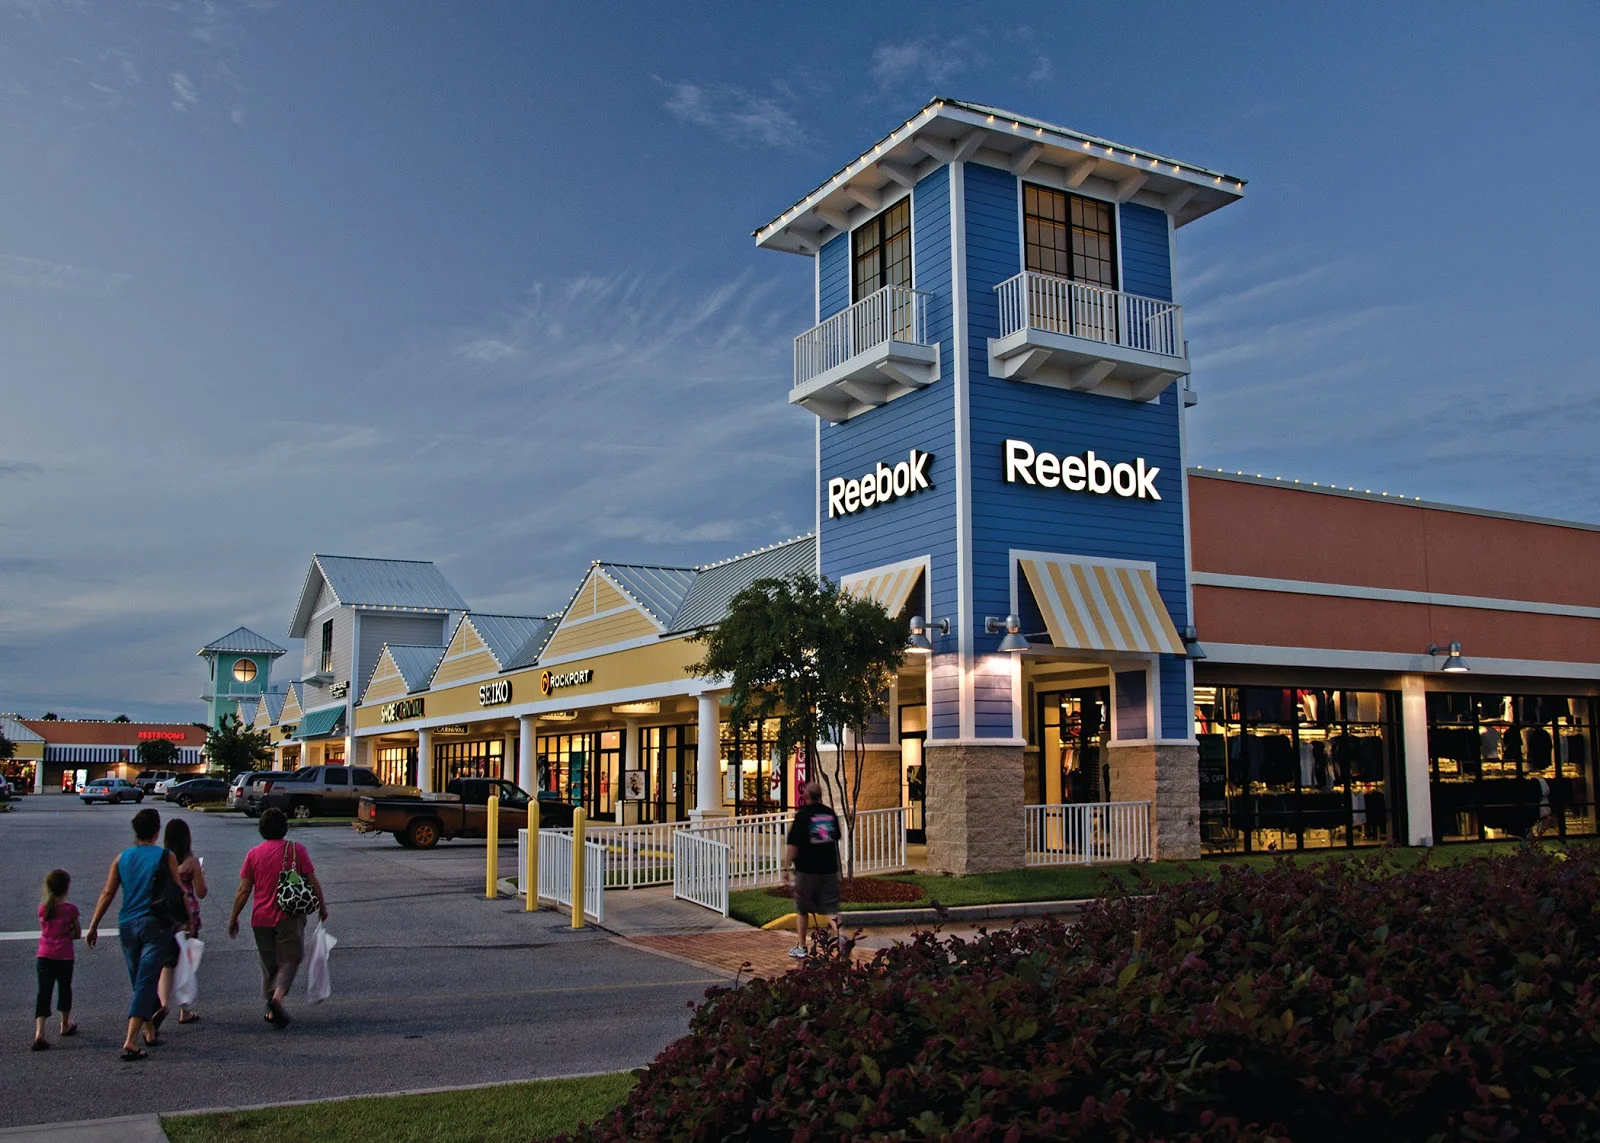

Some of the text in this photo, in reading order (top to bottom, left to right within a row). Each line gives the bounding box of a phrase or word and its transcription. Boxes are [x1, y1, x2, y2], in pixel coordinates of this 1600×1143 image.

[1005, 438, 1162, 501] Reebok
[828, 449, 931, 519] Reebok
[550, 669, 590, 688] ROCKPORT
[479, 679, 509, 706] SEIKO
[381, 703, 395, 723] SHOE
[137, 731, 185, 740] RESTROOMS
[436, 725, 465, 733] CARNIVAL
[1211, 774, 1225, 783] OFF
